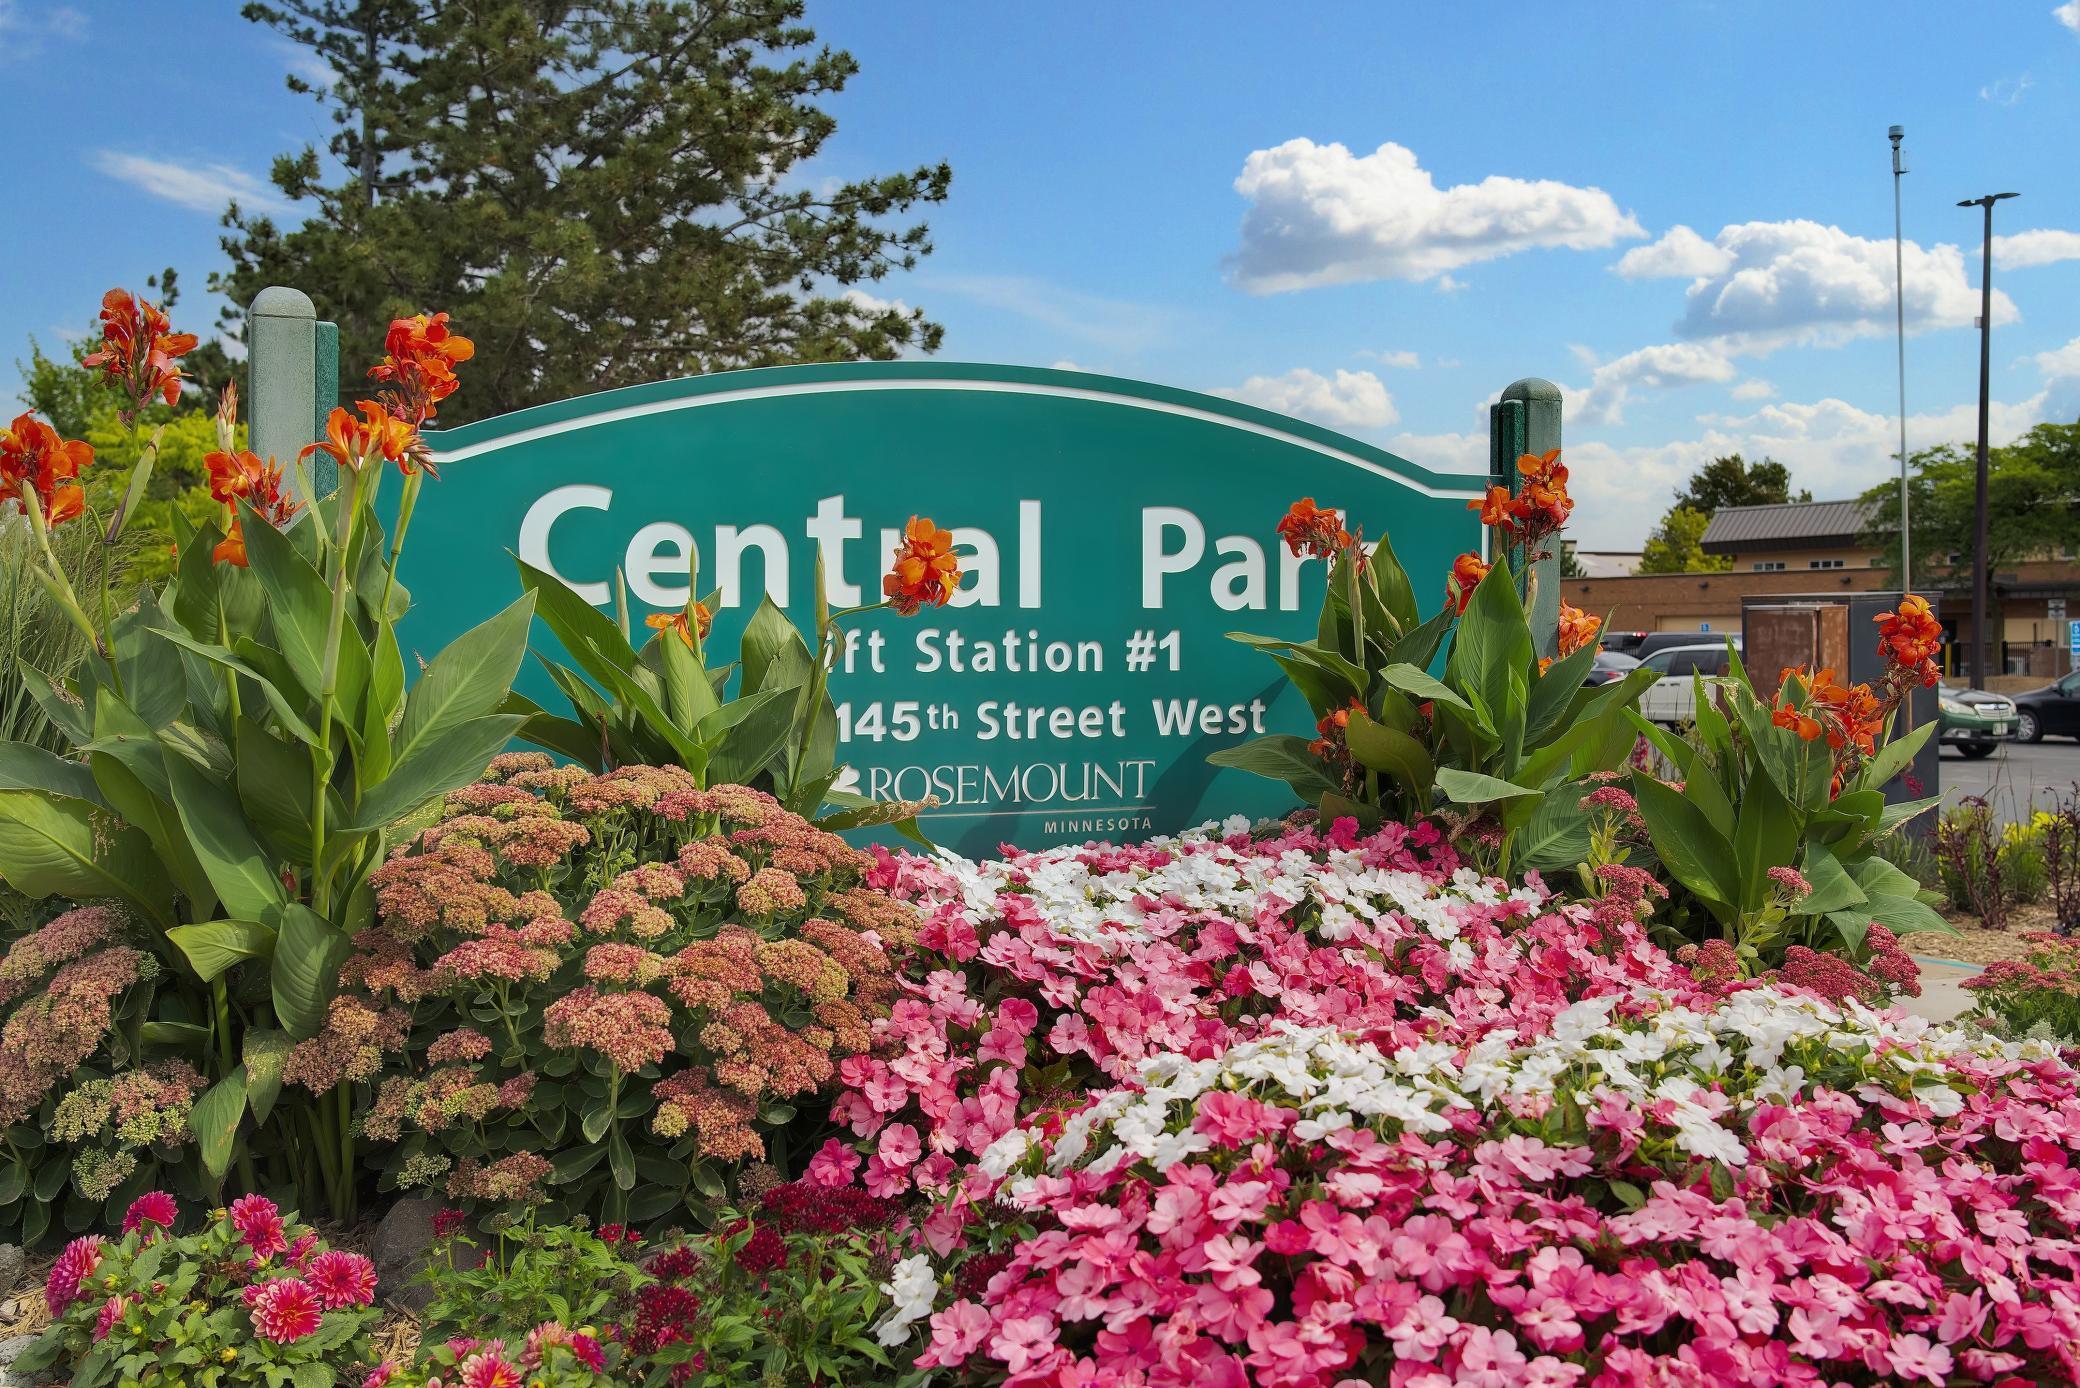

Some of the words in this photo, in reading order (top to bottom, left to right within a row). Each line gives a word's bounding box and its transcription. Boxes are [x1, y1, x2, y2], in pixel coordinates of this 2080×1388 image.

[1142, 506, 1380, 612] Par
[915, 628, 1103, 673] Station
[1126, 629, 1181, 672] #1
[835, 701, 960, 743] 145th
[977, 699, 1127, 740] Street
[1152, 697, 1267, 737] West
[869, 760, 1156, 806] ROSEMOUNT
[1044, 817, 1152, 834] MINNESOTA
